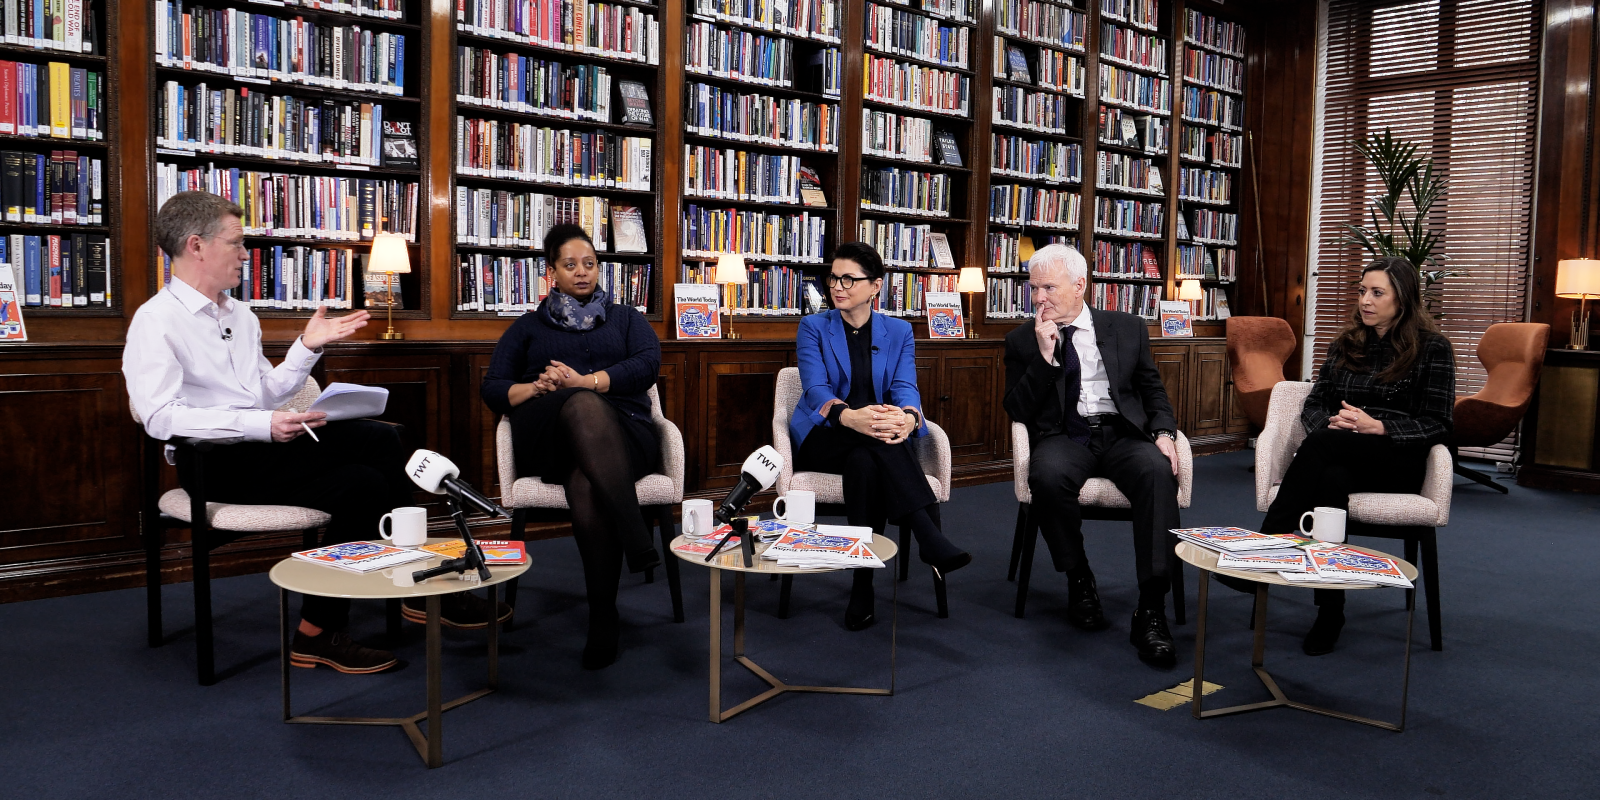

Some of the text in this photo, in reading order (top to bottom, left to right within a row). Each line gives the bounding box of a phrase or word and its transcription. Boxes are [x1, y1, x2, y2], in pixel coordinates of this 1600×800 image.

[74, 21, 80, 32] OF
[0, 282, 12, 290] day
[413, 456, 431, 479] TWT
[757, 452, 777, 472] TWT
